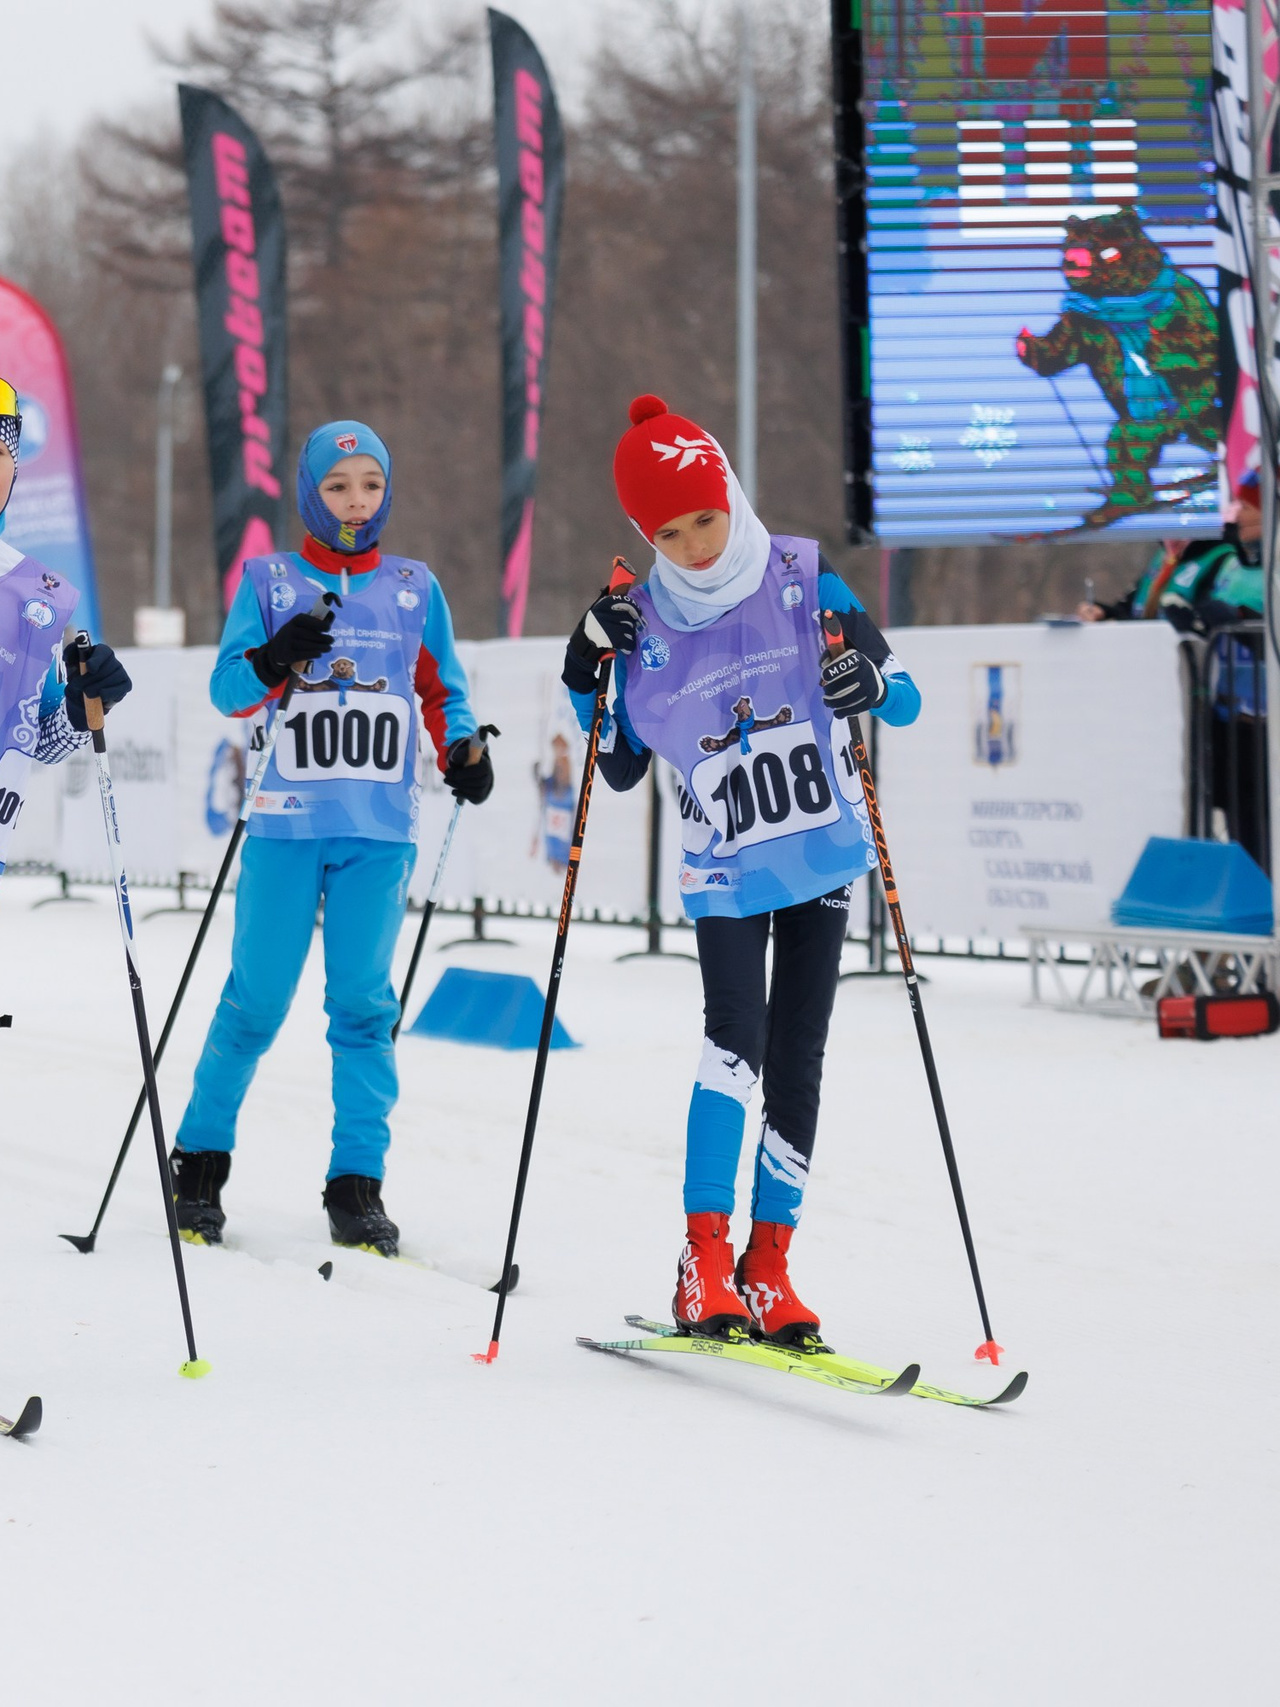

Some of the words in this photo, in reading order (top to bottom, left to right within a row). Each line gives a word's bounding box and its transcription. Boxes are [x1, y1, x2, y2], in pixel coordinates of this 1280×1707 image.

[612, 595, 640, 608] MOA
[828, 654, 860, 677] MOAX
[666, 661, 743, 706] МЕЖДУНАРОДНЫ
[285, 709, 399, 771] 1000
[710, 743, 832, 843] 1008
[690, 1339, 724, 1355] FISCHER
